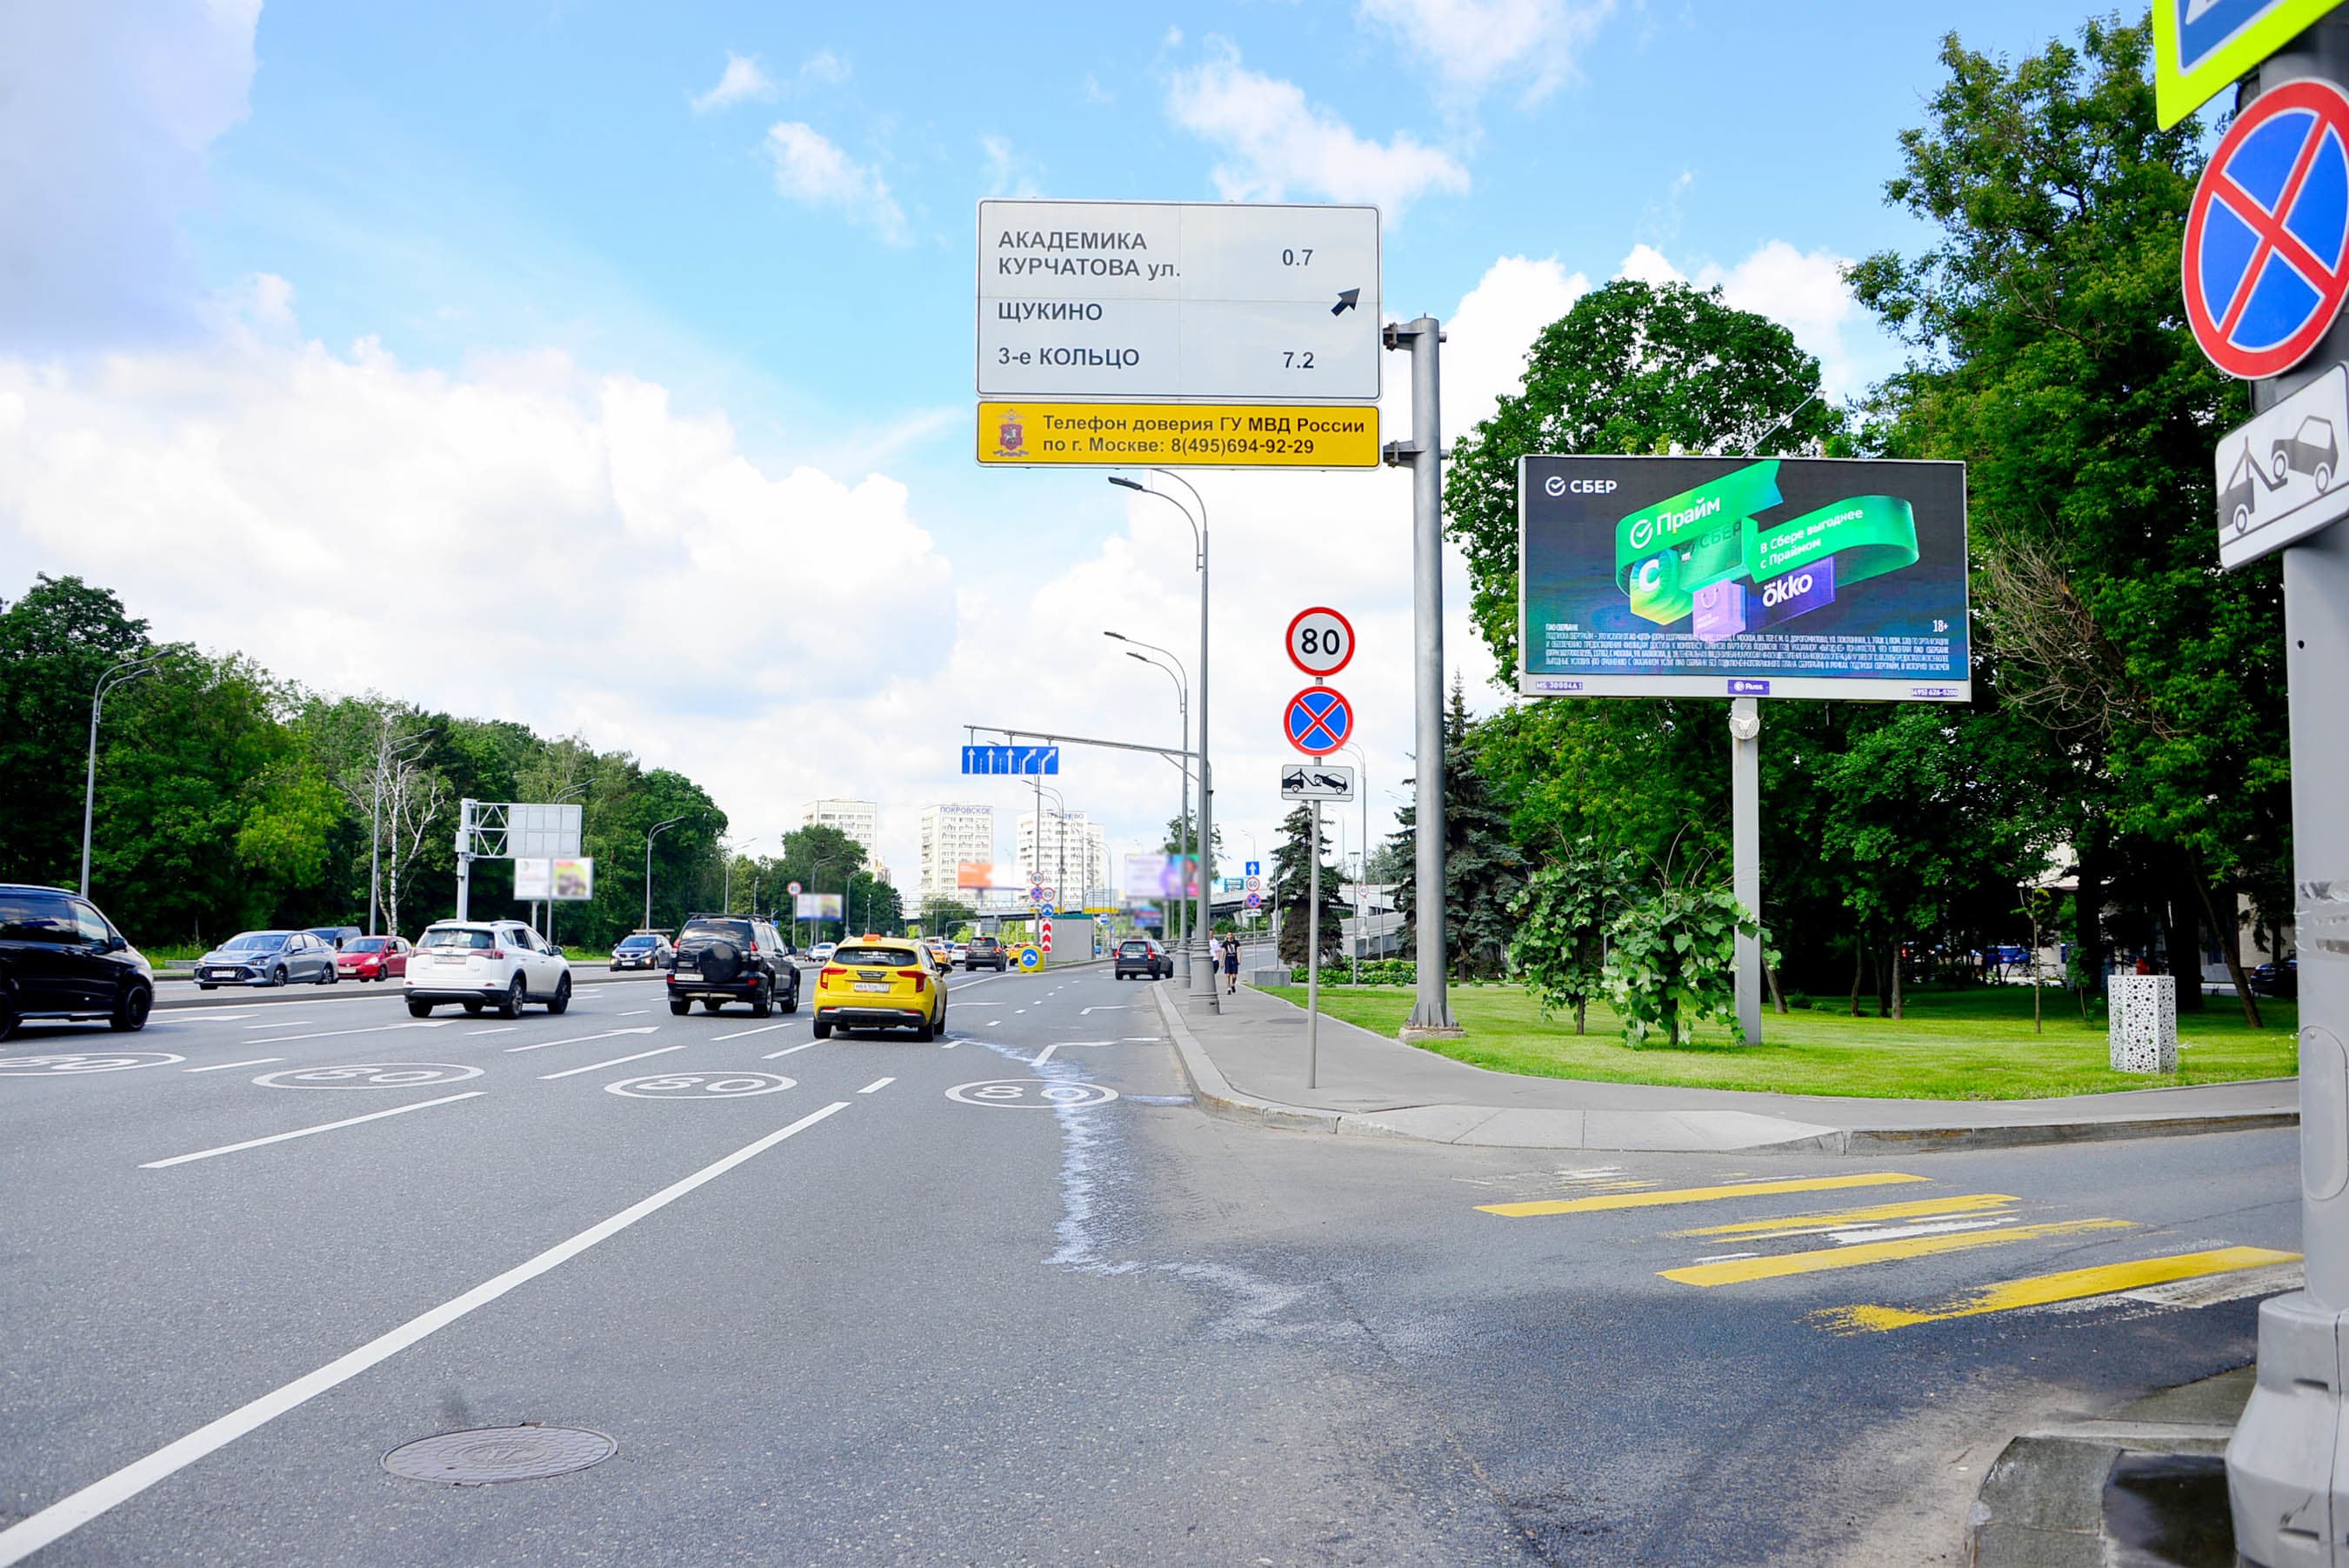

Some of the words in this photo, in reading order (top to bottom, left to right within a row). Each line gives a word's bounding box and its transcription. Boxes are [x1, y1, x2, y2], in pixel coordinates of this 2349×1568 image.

[998, 230, 1148, 252] АКАДЕМИКА
[1281, 249, 1314, 267] 0.7
[998, 257, 1141, 277] КУРЧАТОВА
[1147, 263, 1181, 281] ул.
[998, 302, 1103, 323] ЩУКИНО
[998, 347, 1031, 365] 3-е
[1039, 348, 1140, 369] КОЛЬЦО
[1282, 351, 1315, 370] 7.2
[1043, 414, 1127, 434] Телефон
[1132, 418, 1214, 435] доверия
[1220, 417, 1242, 432] ГУ
[1248, 417, 1291, 435] МВД
[1297, 417, 1365, 433] России
[1043, 439, 1066, 451] по
[1071, 440, 1083, 452] г.
[1089, 437, 1164, 453] Москве:
[1171, 437, 1315, 457] 8(495)694-92-29
[1570, 479, 1618, 494] СБЕР
[1656, 496, 1721, 536] Прайм
[1759, 542, 1768, 554] В
[1770, 529, 1805, 550] Сбере
[1806, 509, 1864, 536] выгоднее
[1769, 537, 1822, 566] Праймом
[1932, 619, 1949, 632] 18+
[1301, 628, 1340, 656] 80
[940, 806, 991, 815] ПОКРОВСКОЕ
[294, 1067, 443, 1083] 80
[635, 1077, 767, 1091] 80
[972, 1085, 1089, 1100] 80
